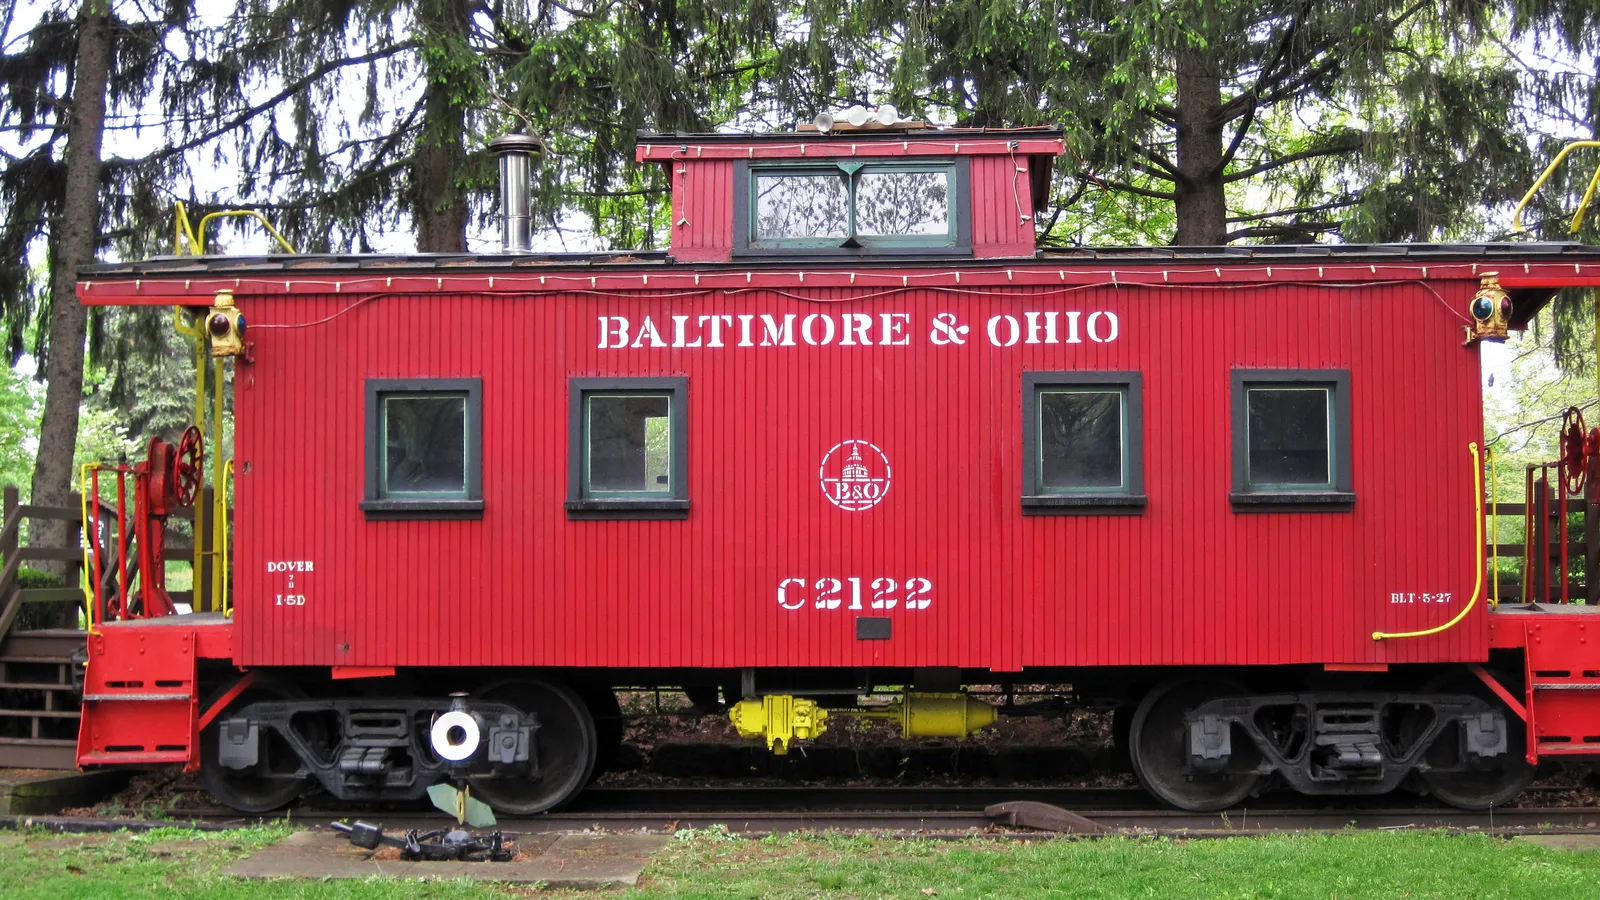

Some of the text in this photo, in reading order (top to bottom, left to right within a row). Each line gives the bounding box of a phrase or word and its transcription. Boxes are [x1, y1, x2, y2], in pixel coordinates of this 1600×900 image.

[598, 311, 1119, 348] BALTIMORE & OHIO
[835, 482, 880, 500] B&O
[267, 561, 314, 572] DOVER
